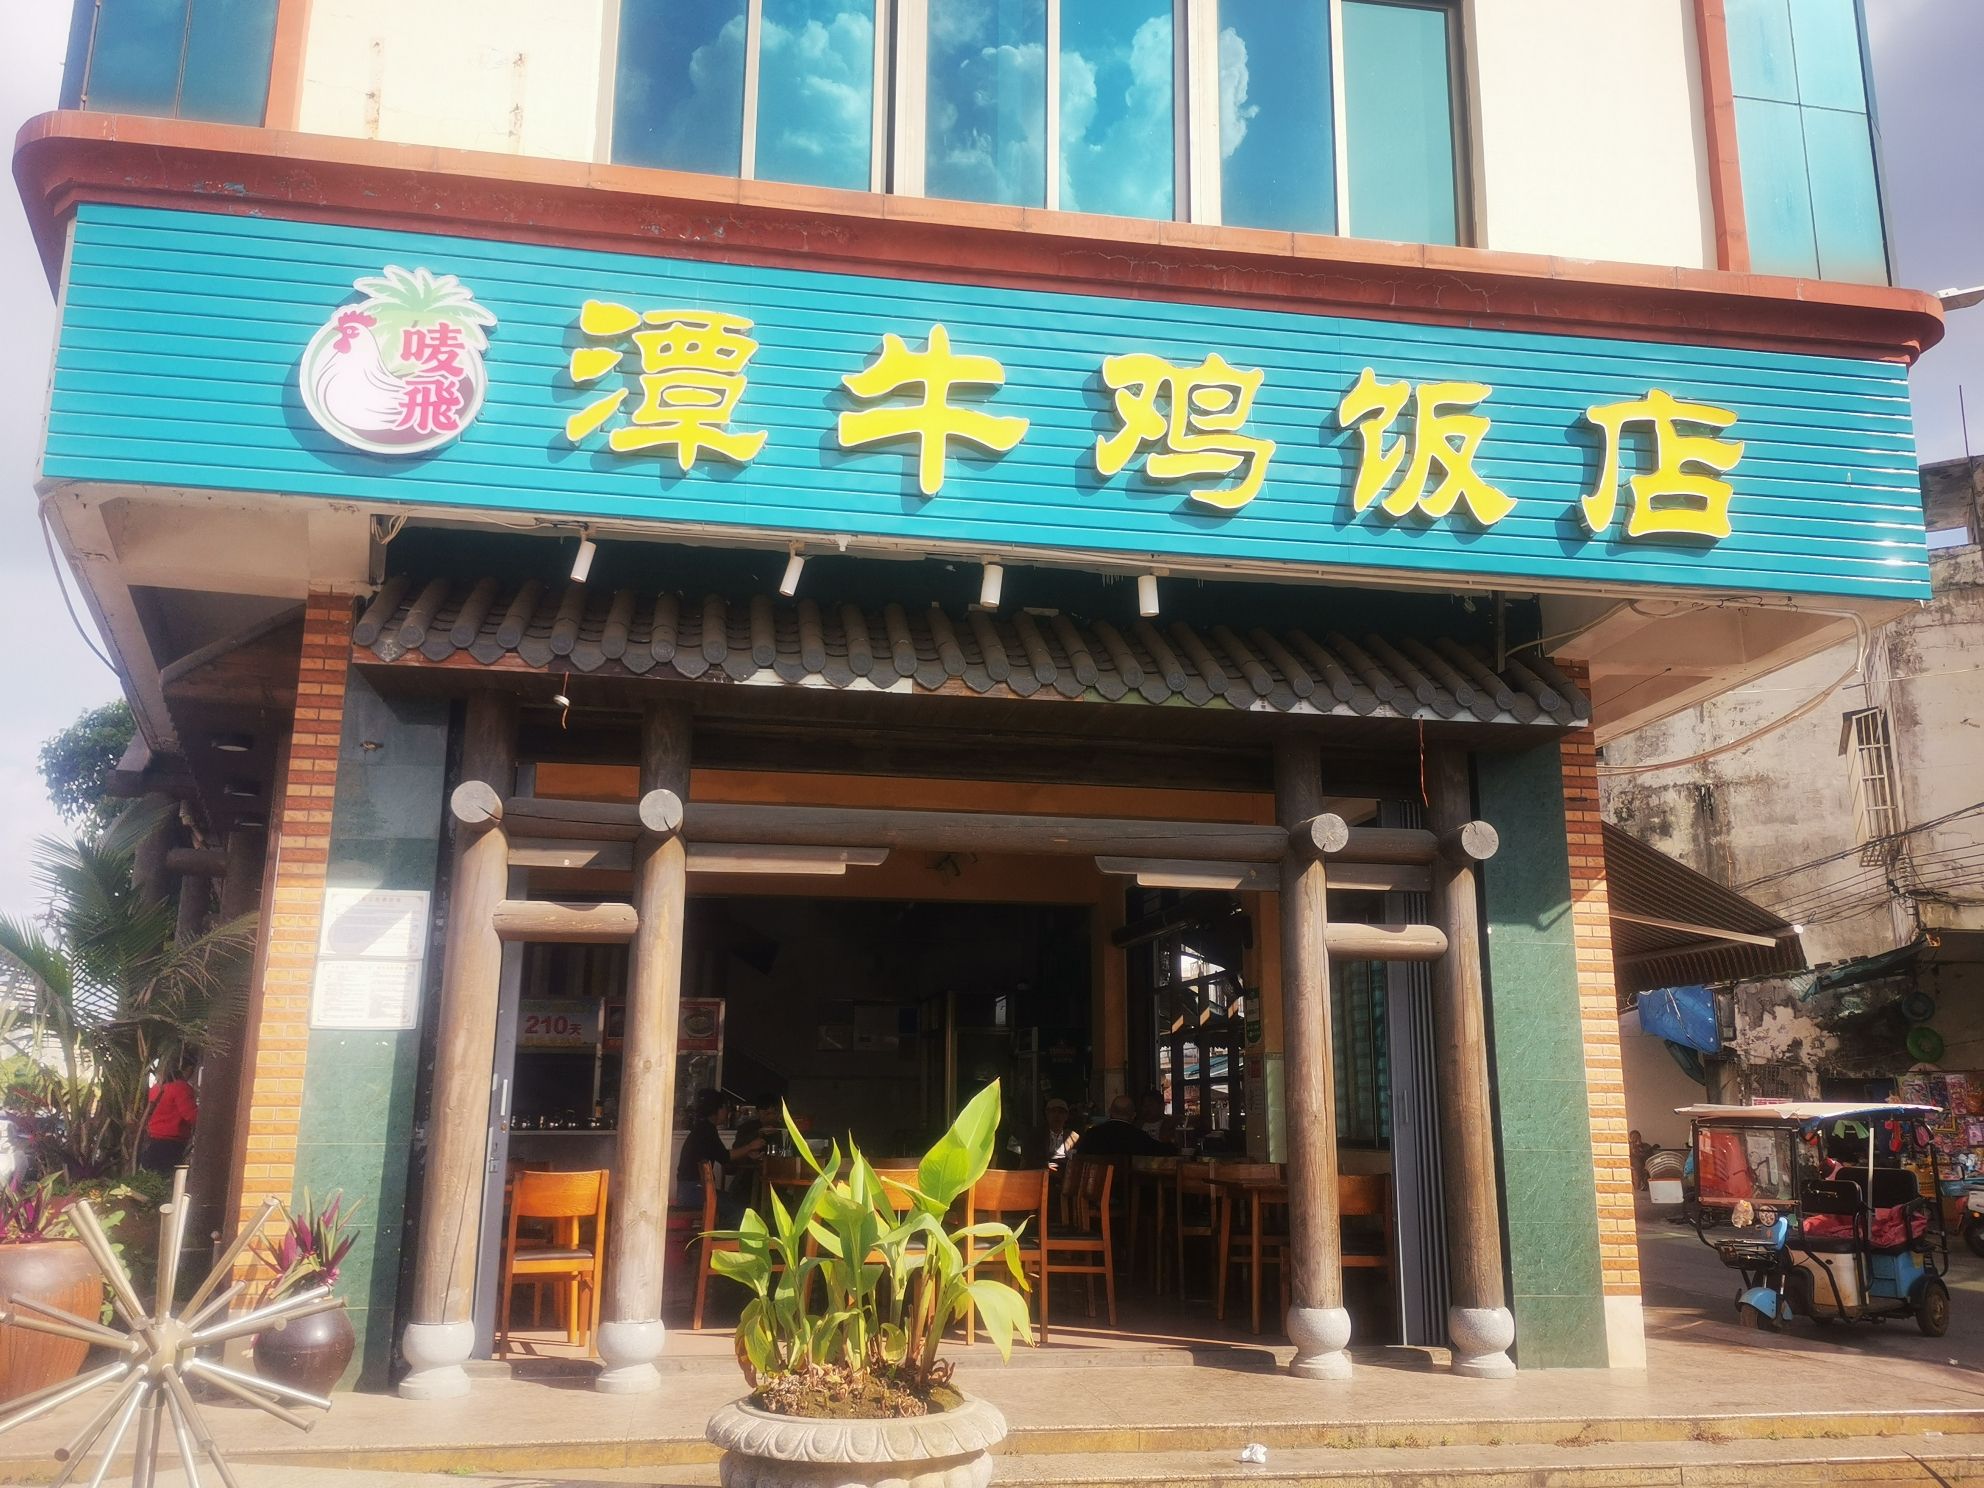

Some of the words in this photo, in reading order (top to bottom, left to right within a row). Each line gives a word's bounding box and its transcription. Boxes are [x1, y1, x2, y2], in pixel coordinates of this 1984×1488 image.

[394, 321, 465, 433] 唛飛
[565, 299, 1746, 541] 潭牛鸡饭店
